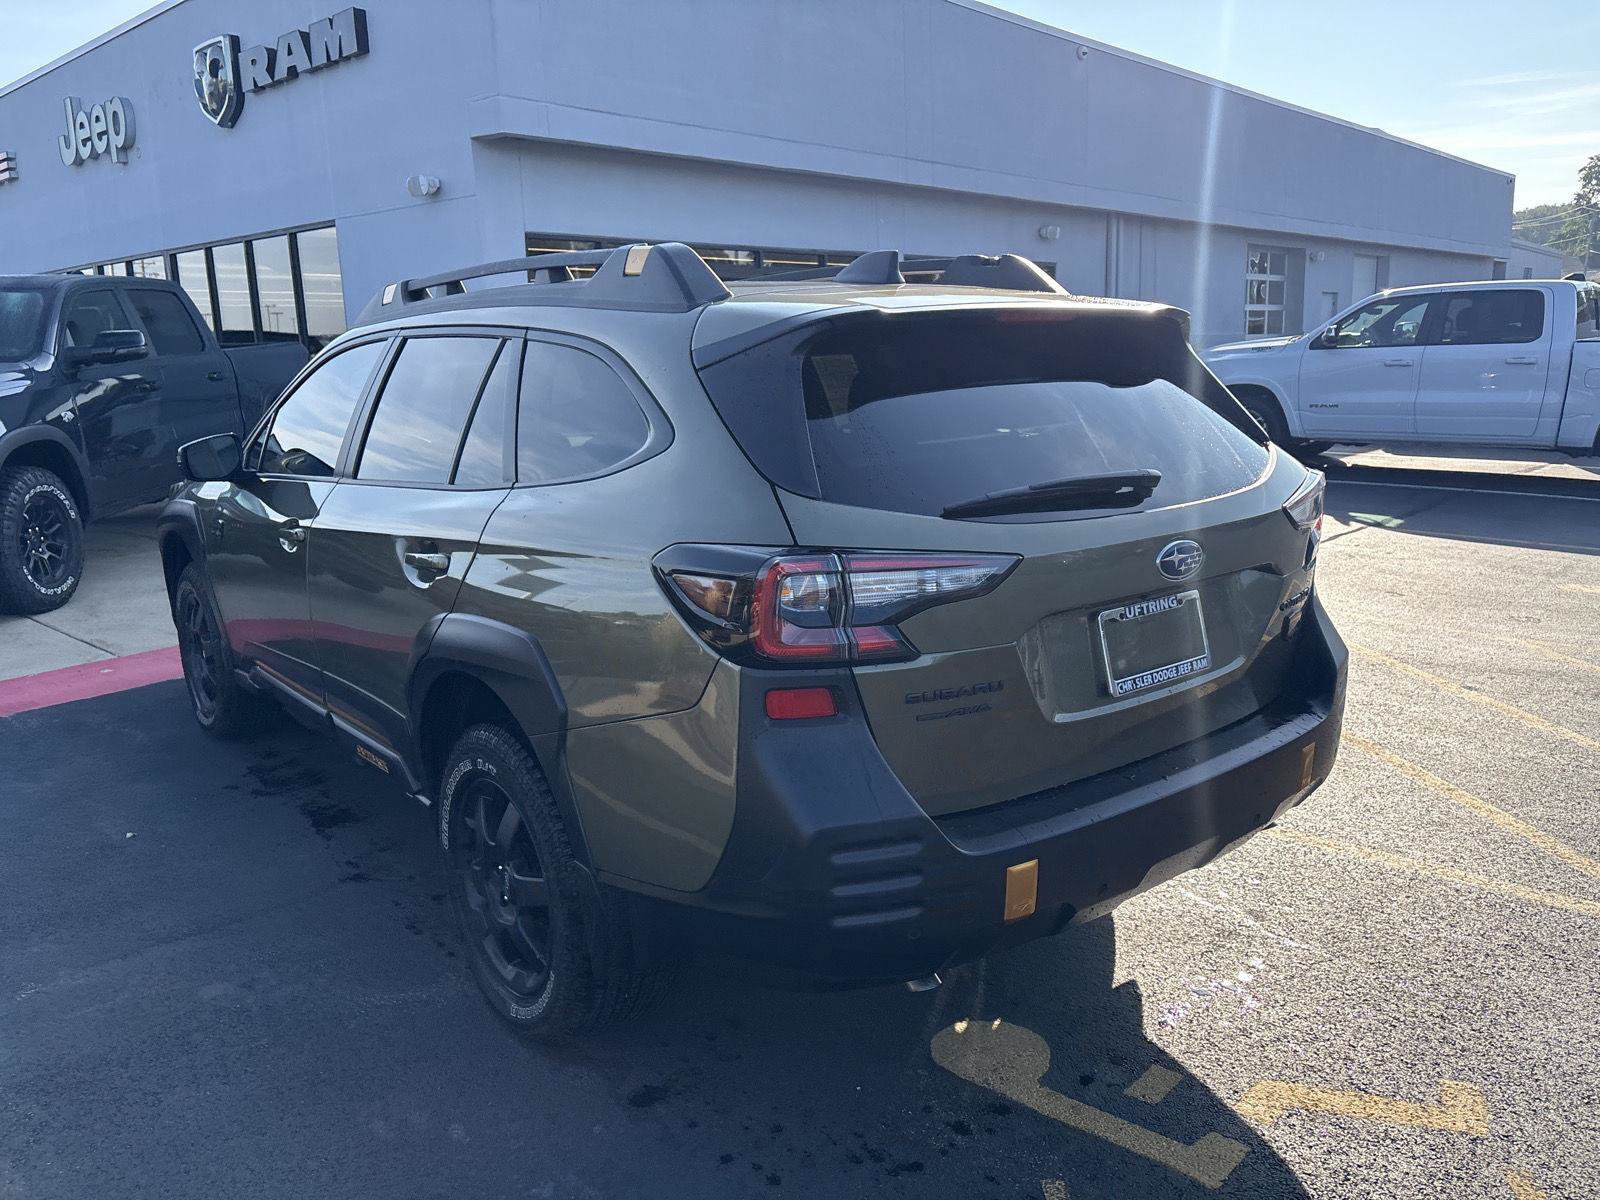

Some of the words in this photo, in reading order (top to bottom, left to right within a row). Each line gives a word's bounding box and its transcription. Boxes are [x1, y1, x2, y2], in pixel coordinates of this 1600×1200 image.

[238, 7, 368, 93] RAM
[58, 96, 134, 167] Jeep
[1125, 596, 1178, 618] UFTRING
[1153, 667, 1177, 682] DODGE
[1192, 658, 1208, 670] RAM
[904, 680, 1005, 705] SUBARU
